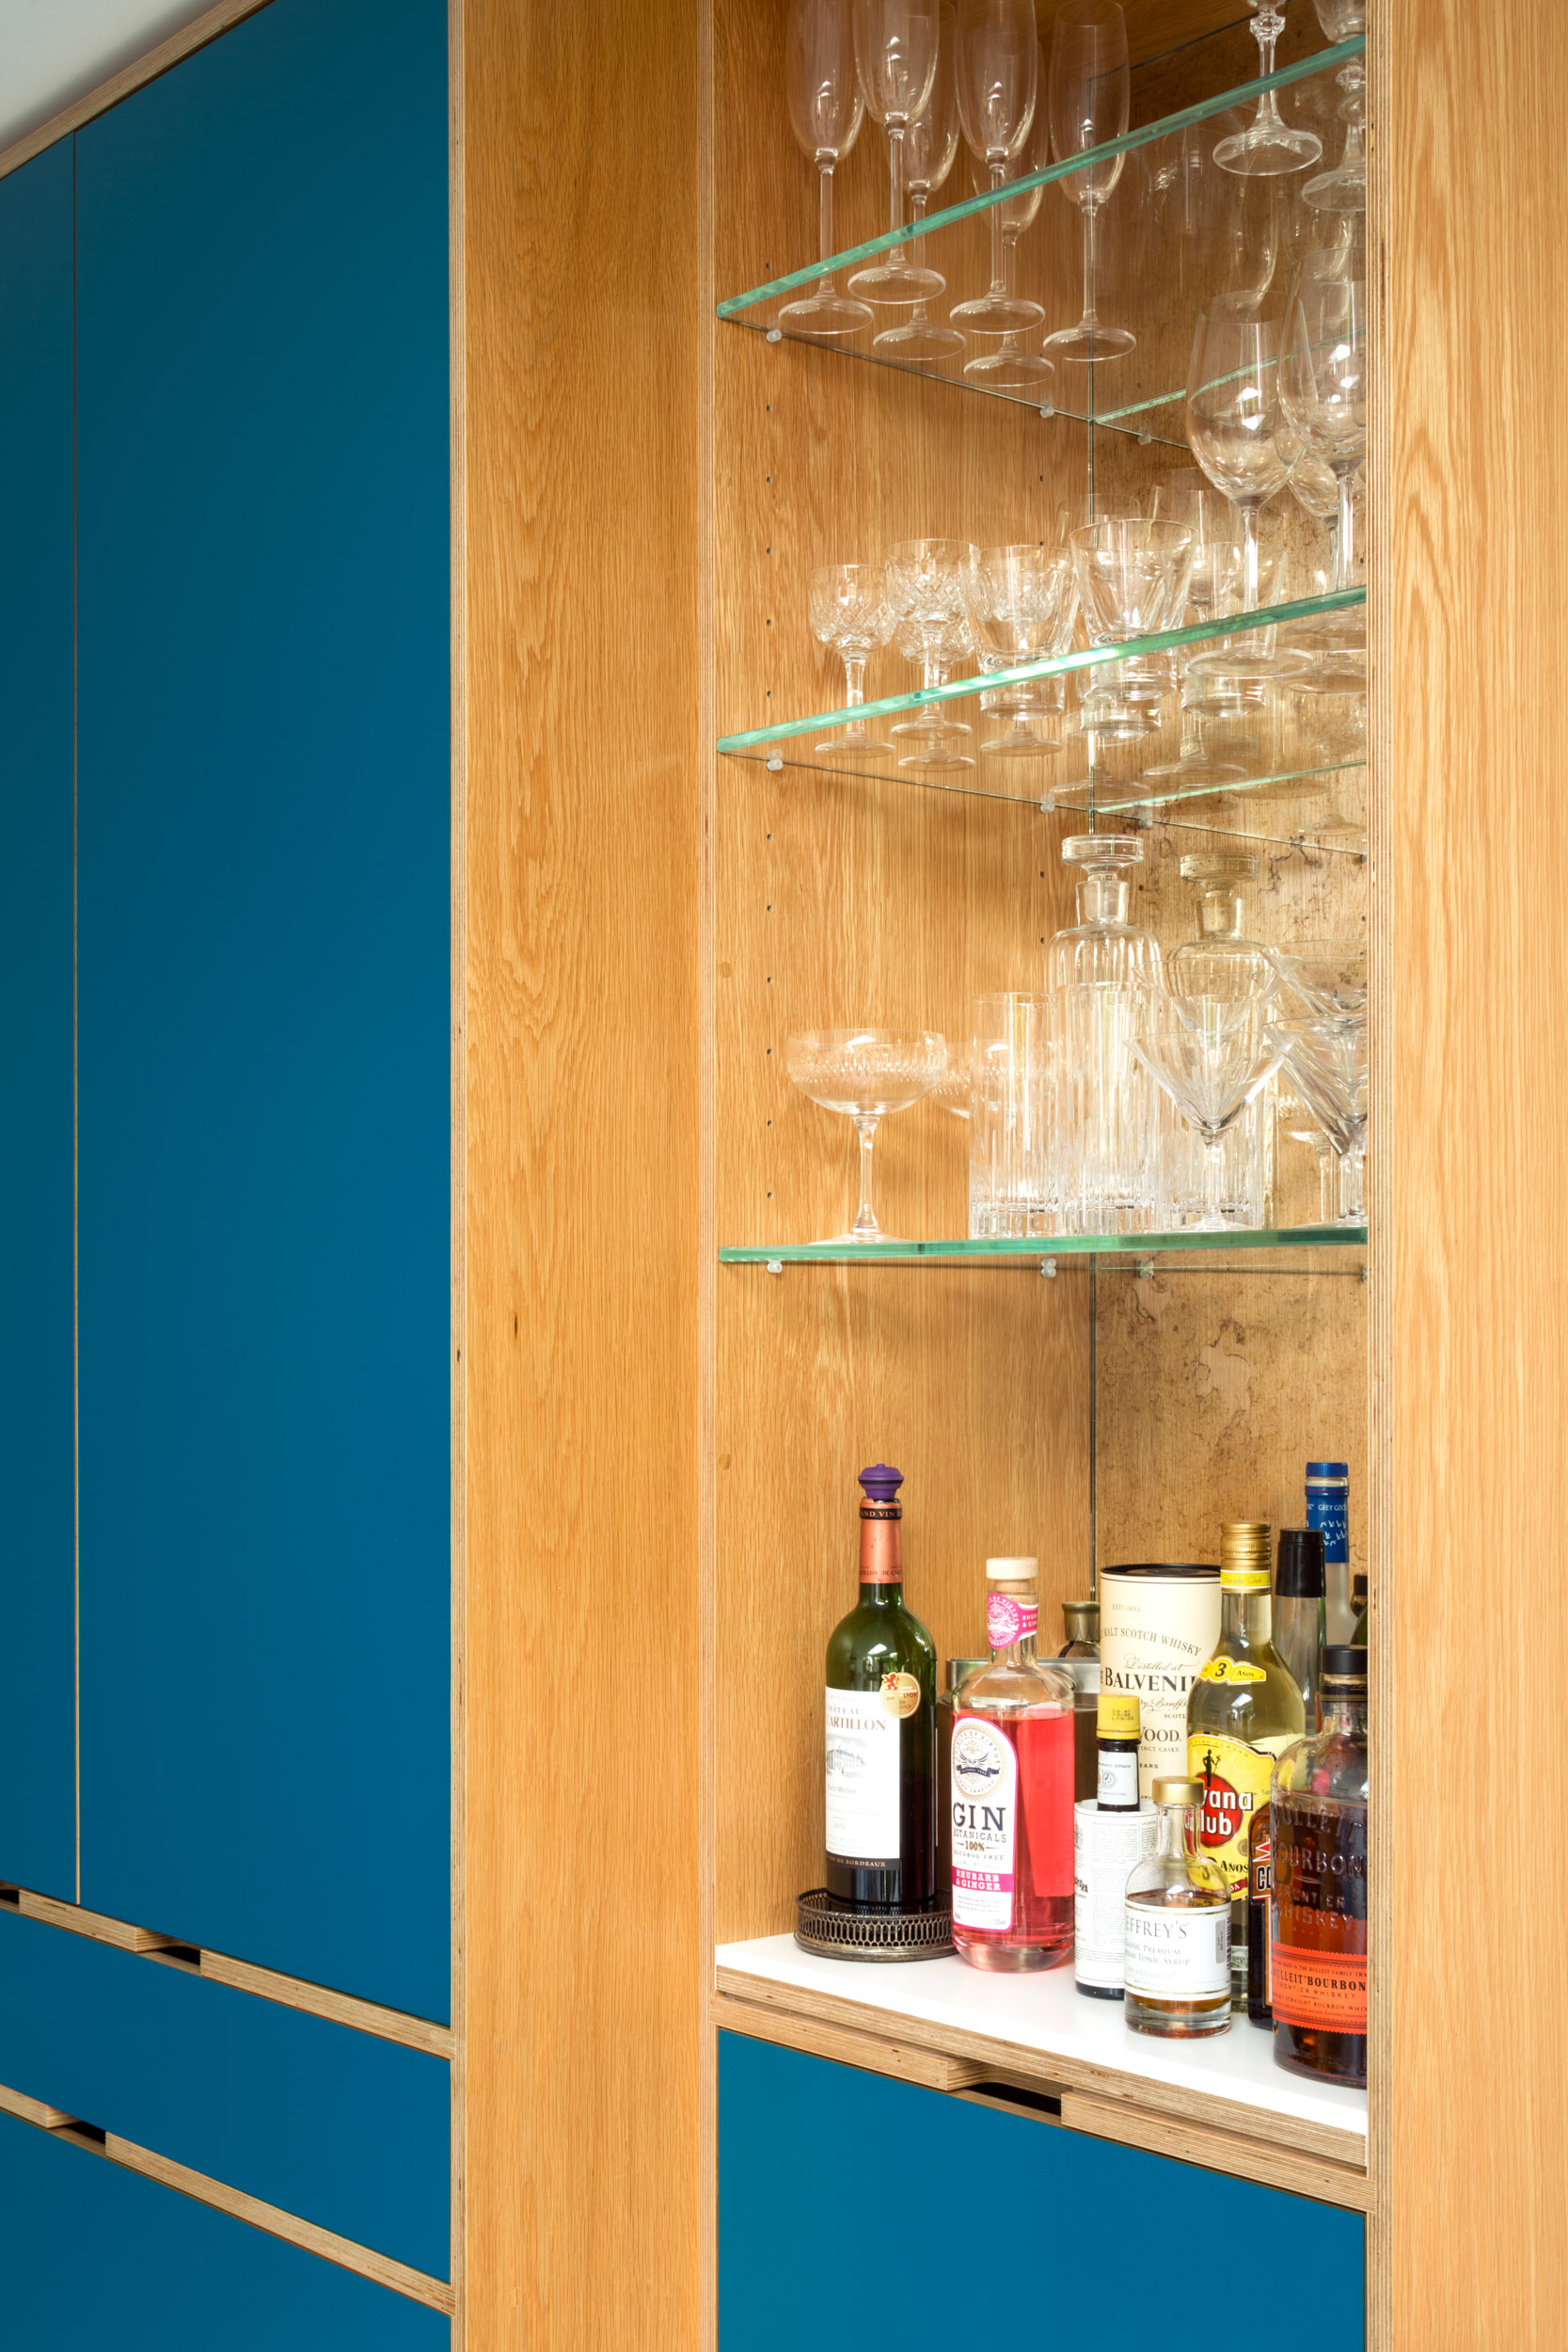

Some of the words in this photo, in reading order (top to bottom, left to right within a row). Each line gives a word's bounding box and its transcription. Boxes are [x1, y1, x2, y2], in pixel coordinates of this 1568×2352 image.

[1103, 1627, 1119, 1637] MALT
[1120, 1627, 1158, 1644] SCOTCH
[1161, 1634, 1202, 1657] WHISKY
[1122, 1652, 1171, 1672] Distilled
[1214, 1662, 1227, 1677] 3
[953, 1802, 1006, 1832] GIN
[953, 1827, 1007, 1844] BOTANICALS
[965, 1839, 985, 1852] 100%
[846, 1859, 886, 1868] BORDEAUX
[1271, 1839, 1364, 1879] BOURBON
[956, 1867, 1001, 1883] RHUBARB
[956, 1877, 960, 1886] &
[961, 1878, 1002, 1892] GINGER
[1144, 1944, 1181, 1956] PREMIUM
[1138, 1952, 1162, 1964] TONIC
[1164, 1958, 1190, 1966] SYRUP
[1309, 1966, 1330, 1975] BULLEIT
[1277, 1981, 1309, 1994] FRONTIER
[1313, 1990, 1355, 2000] WHISKEY
[1307, 1976, 1366, 1992] BOURBON
[1285, 1994, 1311, 2006] STRAIGHT
[1313, 2001, 1345, 2010] BOURBON
